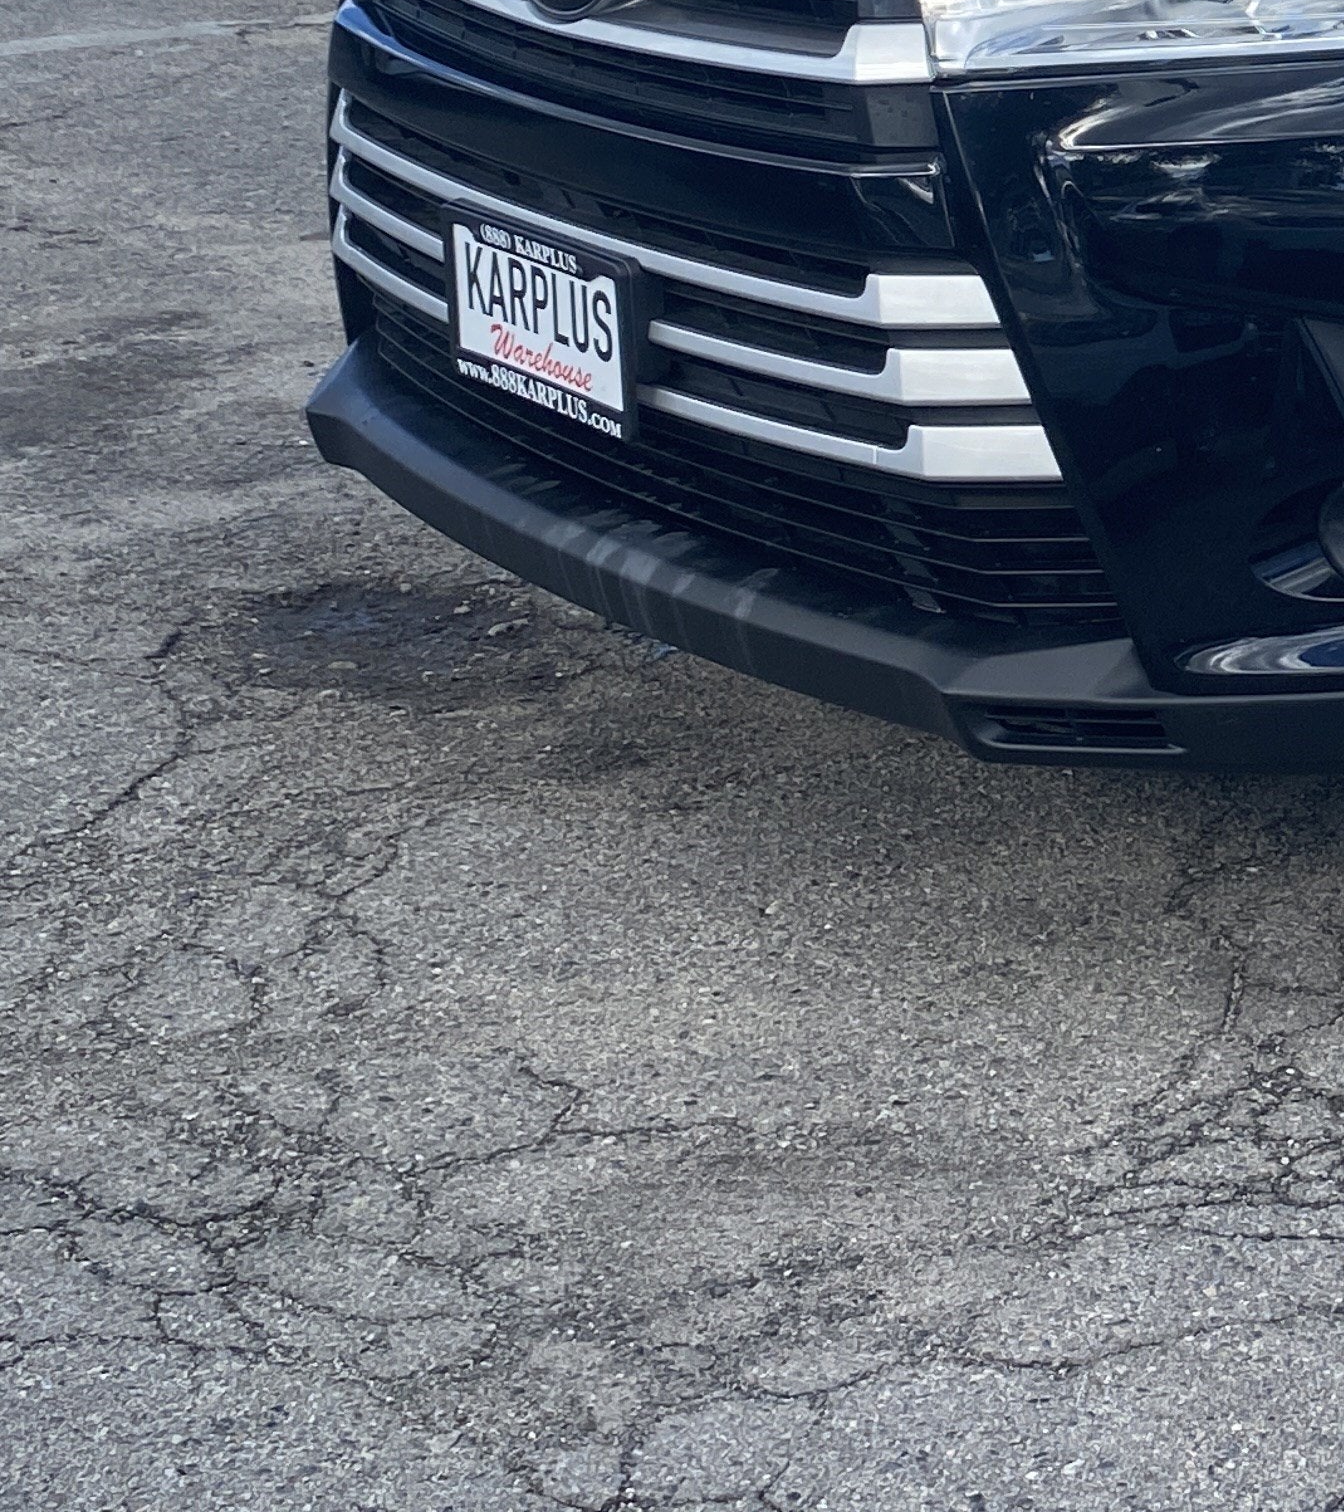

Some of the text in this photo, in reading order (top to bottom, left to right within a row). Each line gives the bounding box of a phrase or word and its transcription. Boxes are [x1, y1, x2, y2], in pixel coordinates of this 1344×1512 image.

[479, 223, 579, 275] (888) KARPLUS
[464, 240, 614, 363] KARPLUS
[490, 323, 594, 393] Warehouse
